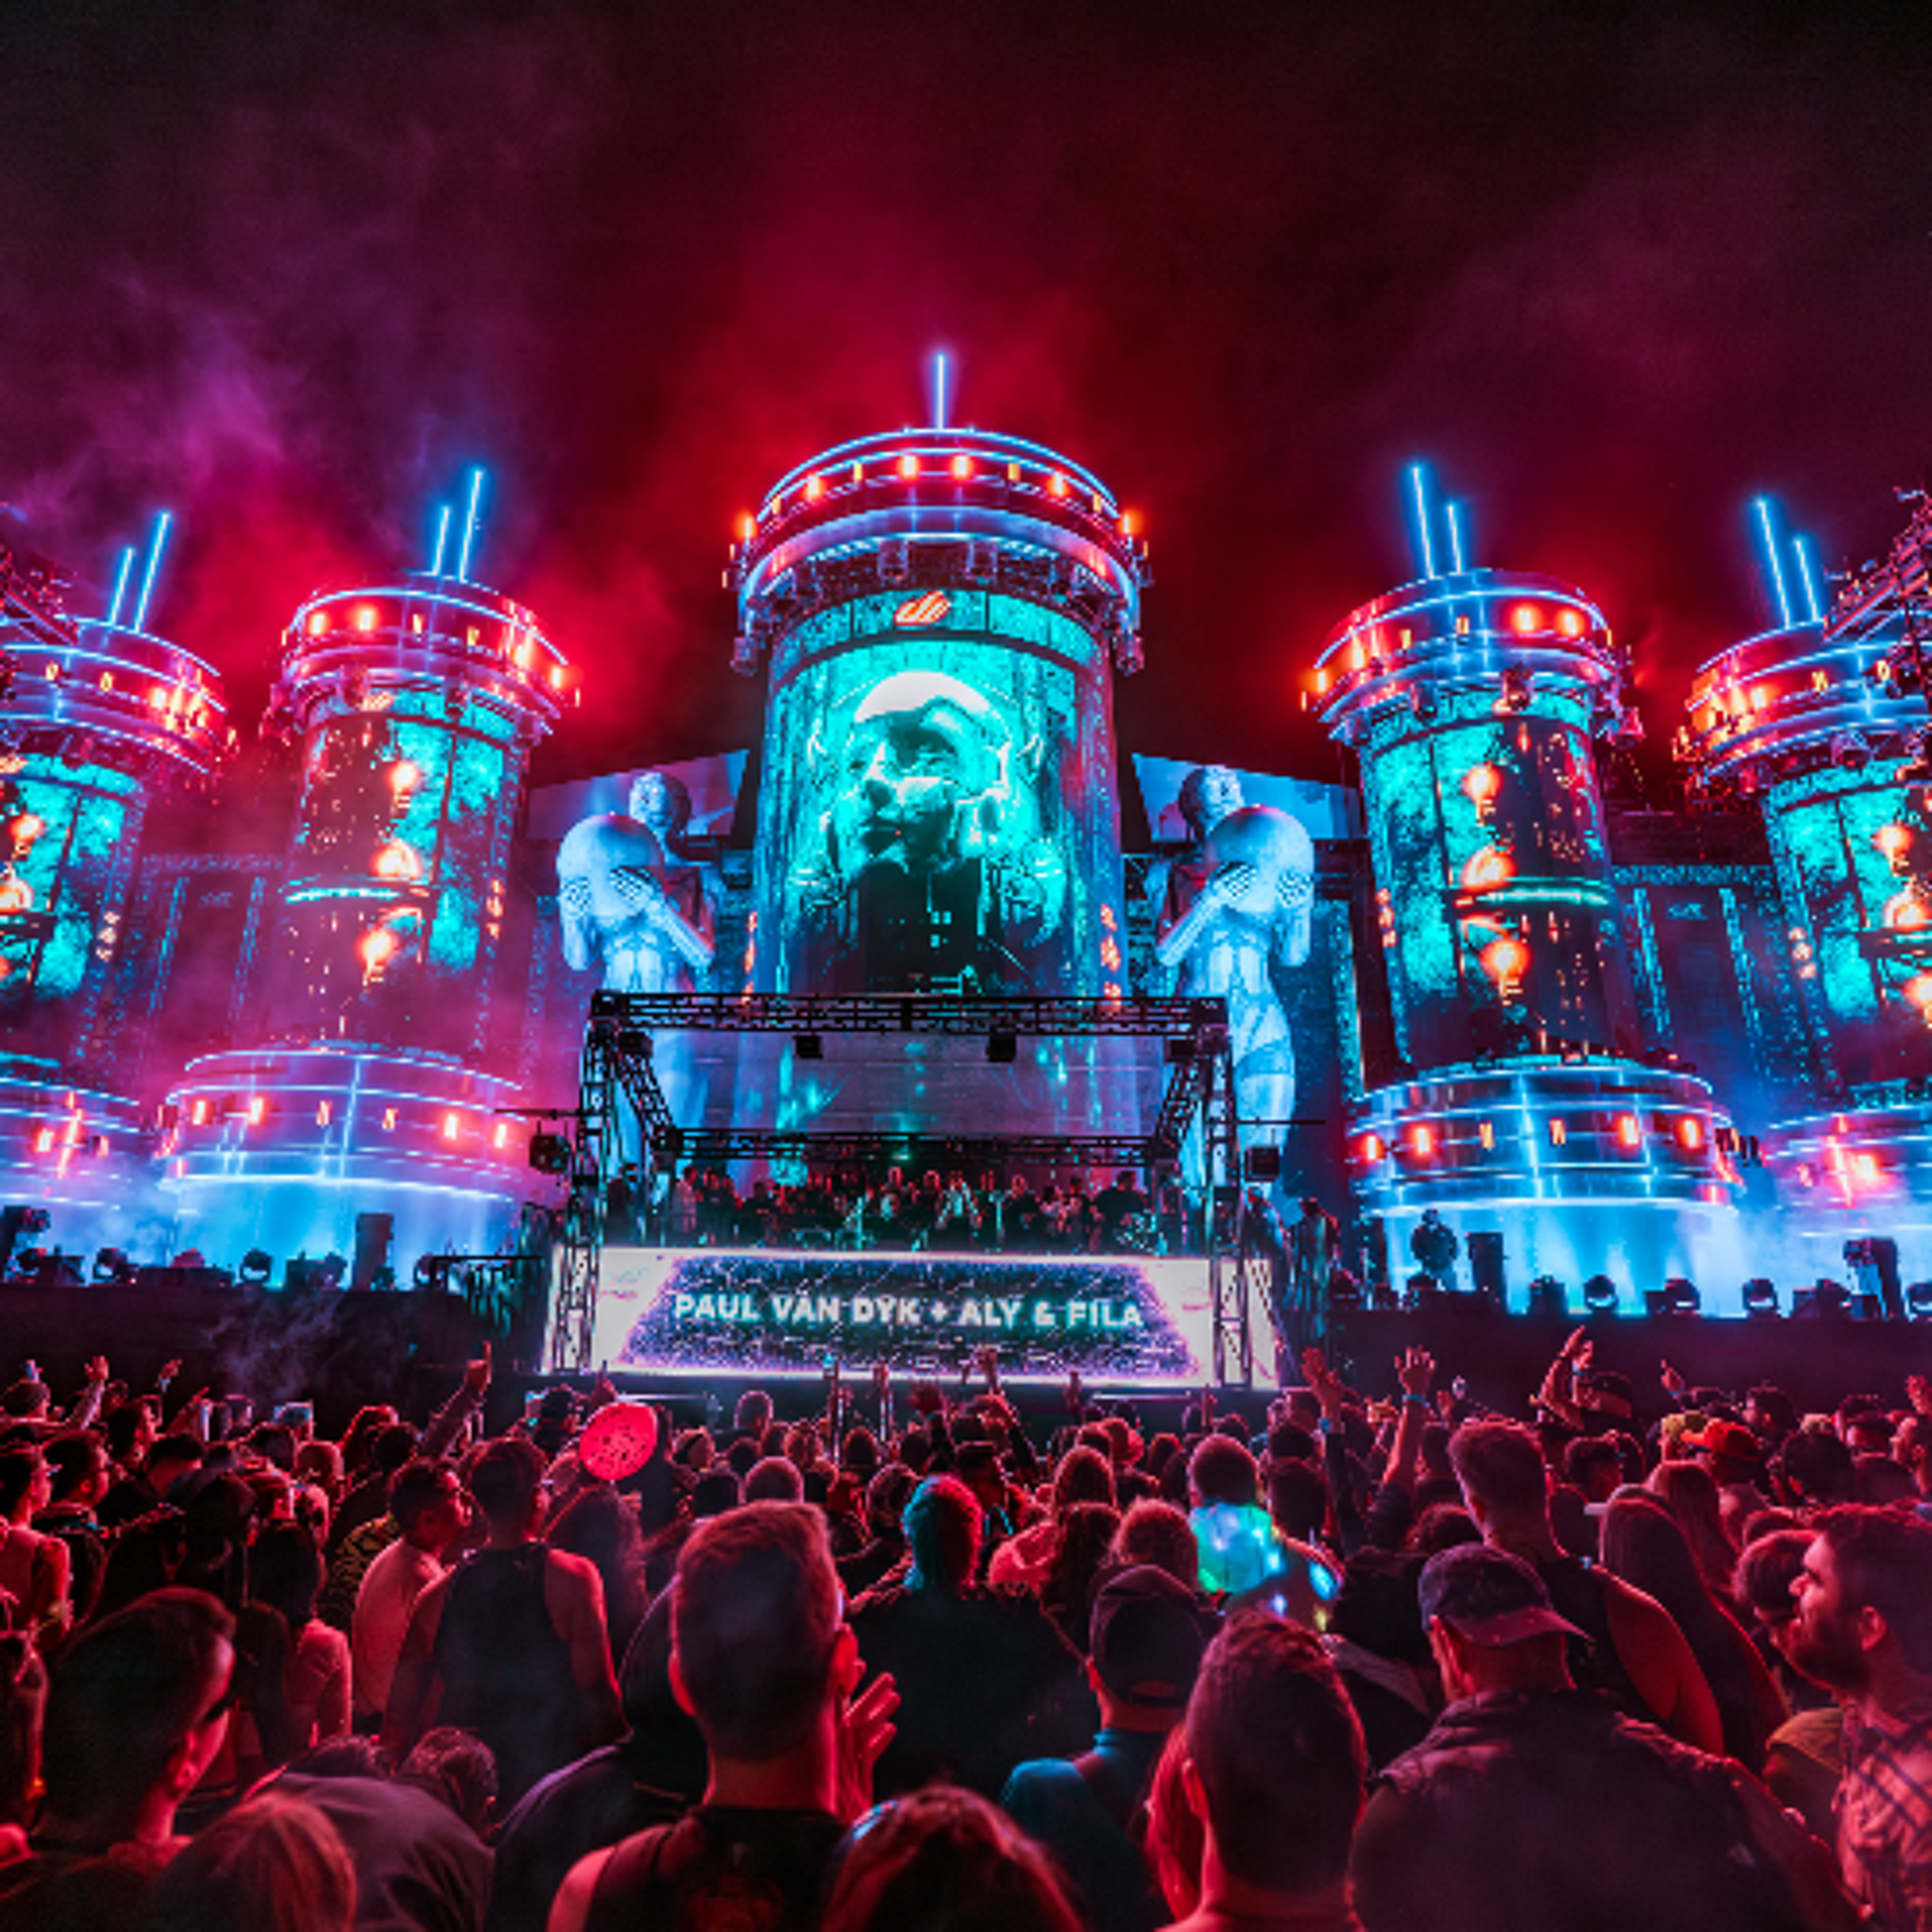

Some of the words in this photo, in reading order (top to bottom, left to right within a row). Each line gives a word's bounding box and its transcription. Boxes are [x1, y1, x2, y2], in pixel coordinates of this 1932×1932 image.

[676, 1294, 759, 1320] PAUL
[773, 1295, 839, 1322] VAN
[853, 1296, 920, 1323] DYK
[958, 1298, 1021, 1327] ALY
[1033, 1301, 1056, 1325] &
[1066, 1300, 1143, 1327] FILA
